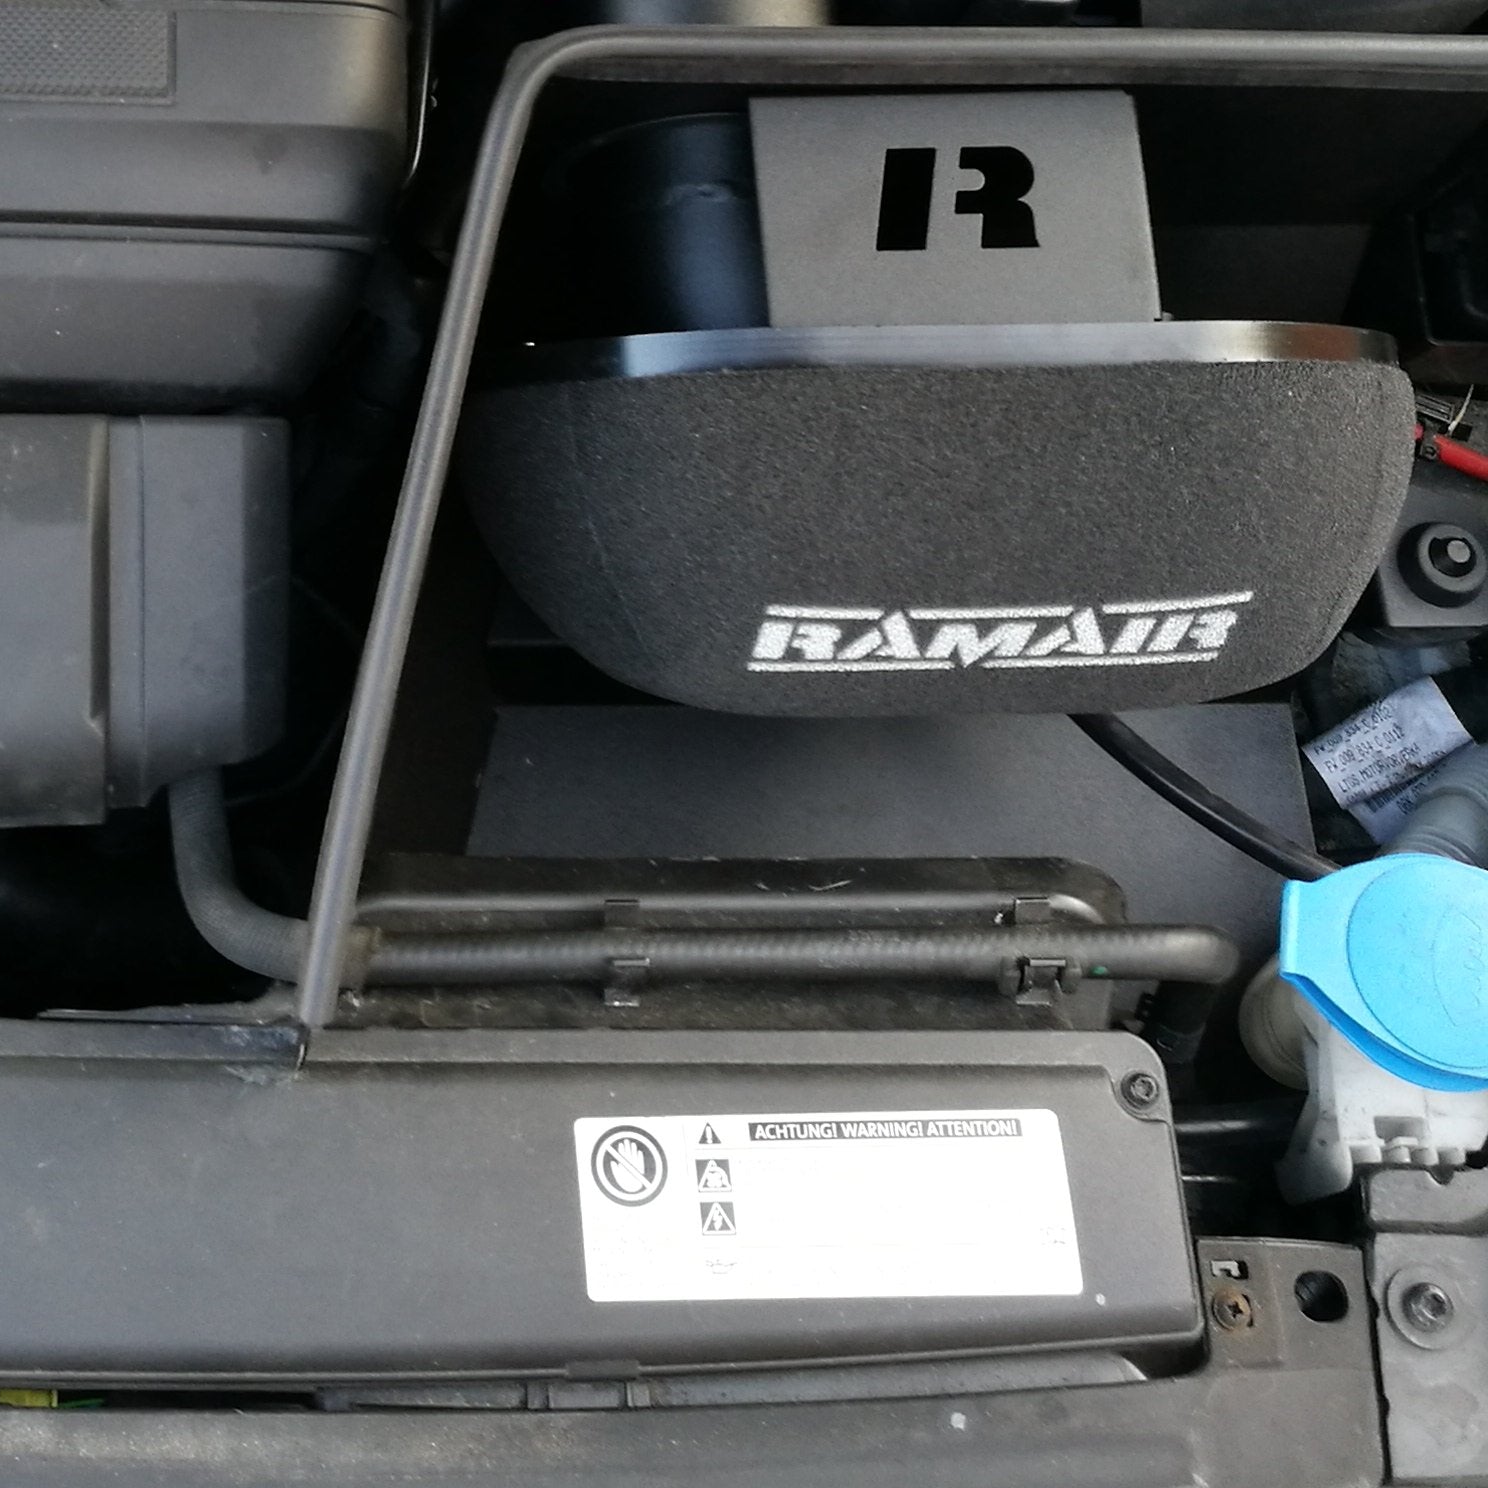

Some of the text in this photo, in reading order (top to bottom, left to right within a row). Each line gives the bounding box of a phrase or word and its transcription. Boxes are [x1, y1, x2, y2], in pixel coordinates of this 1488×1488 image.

[751, 605, 1240, 669] RAMAIR
[754, 1119, 1018, 1140] ACHTUNG! WARNING! ATTENTION!
